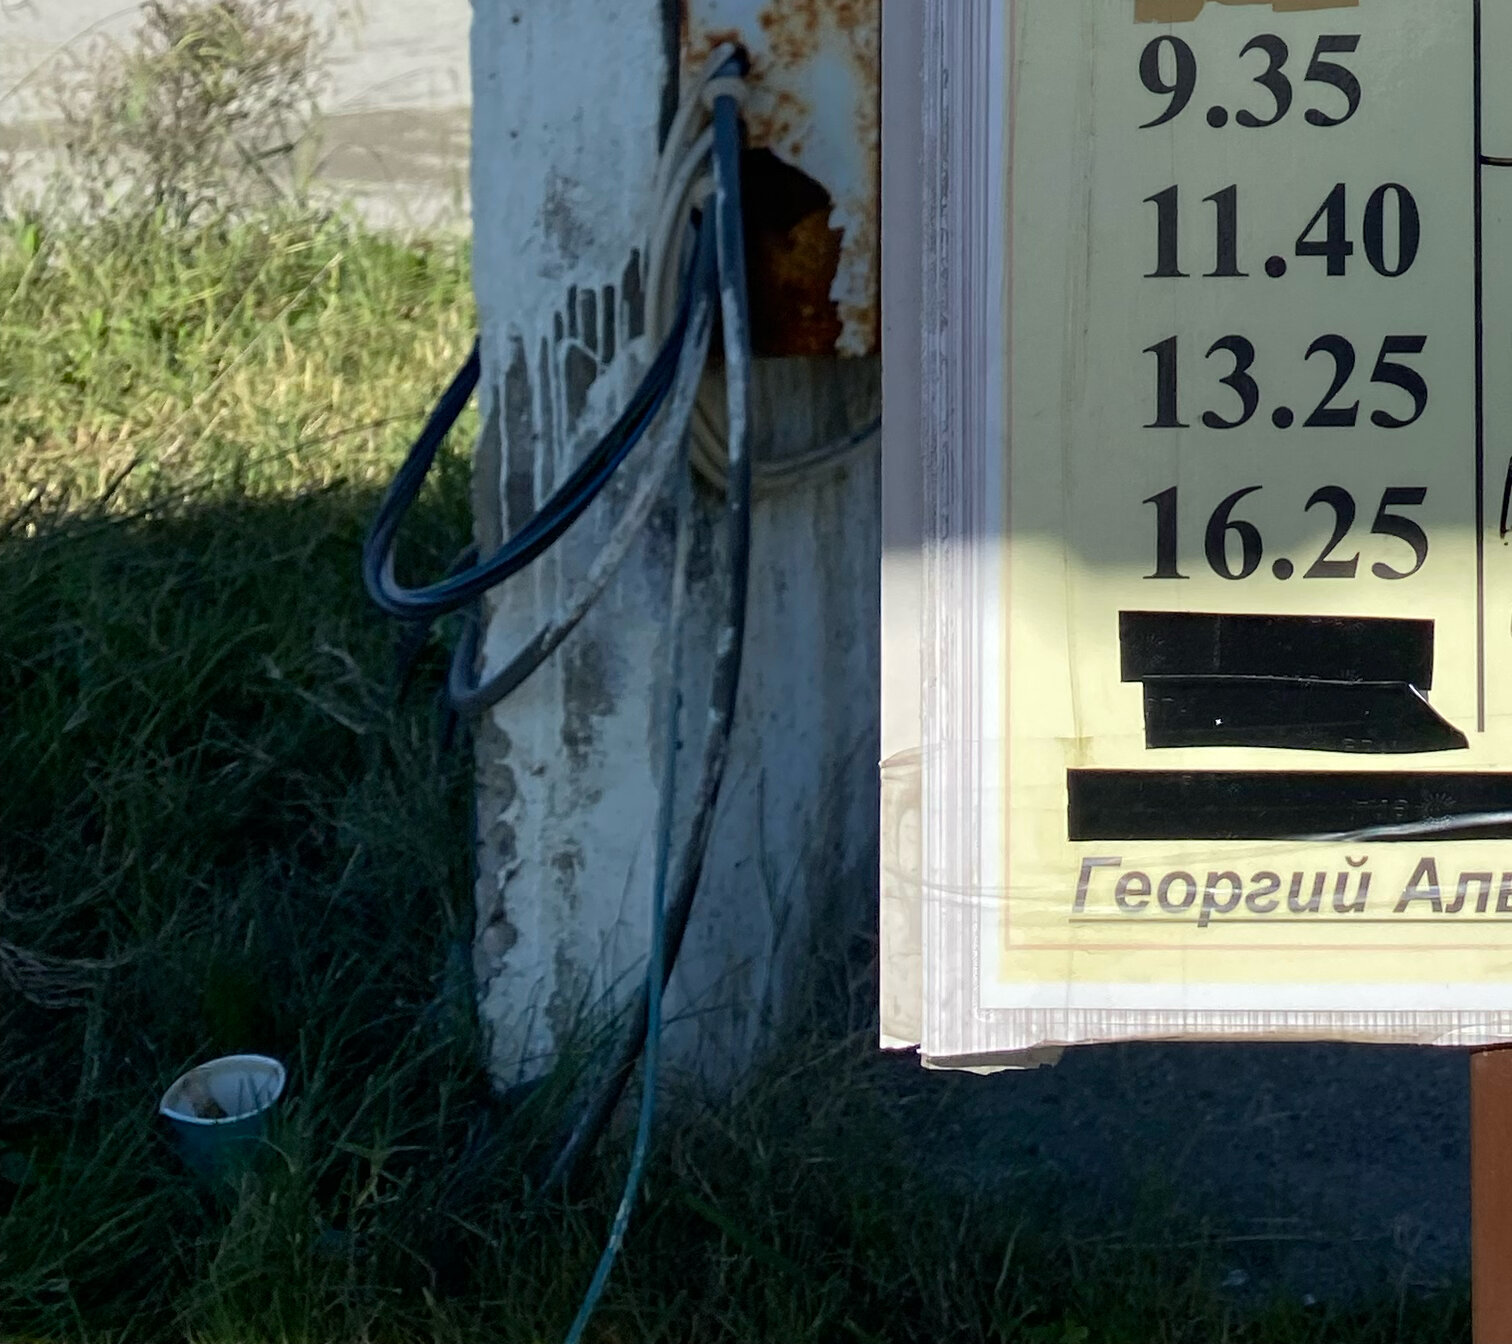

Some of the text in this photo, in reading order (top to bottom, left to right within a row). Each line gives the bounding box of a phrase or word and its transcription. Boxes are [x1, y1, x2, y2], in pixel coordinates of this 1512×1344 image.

[1139, 34, 1361, 128] 9.35
[1143, 183, 1420, 278] 11.40
[1143, 334, 1427, 429] 13.25
[1142, 485, 1428, 580] 16.25
[1074, 855, 1374, 928] Георгий
